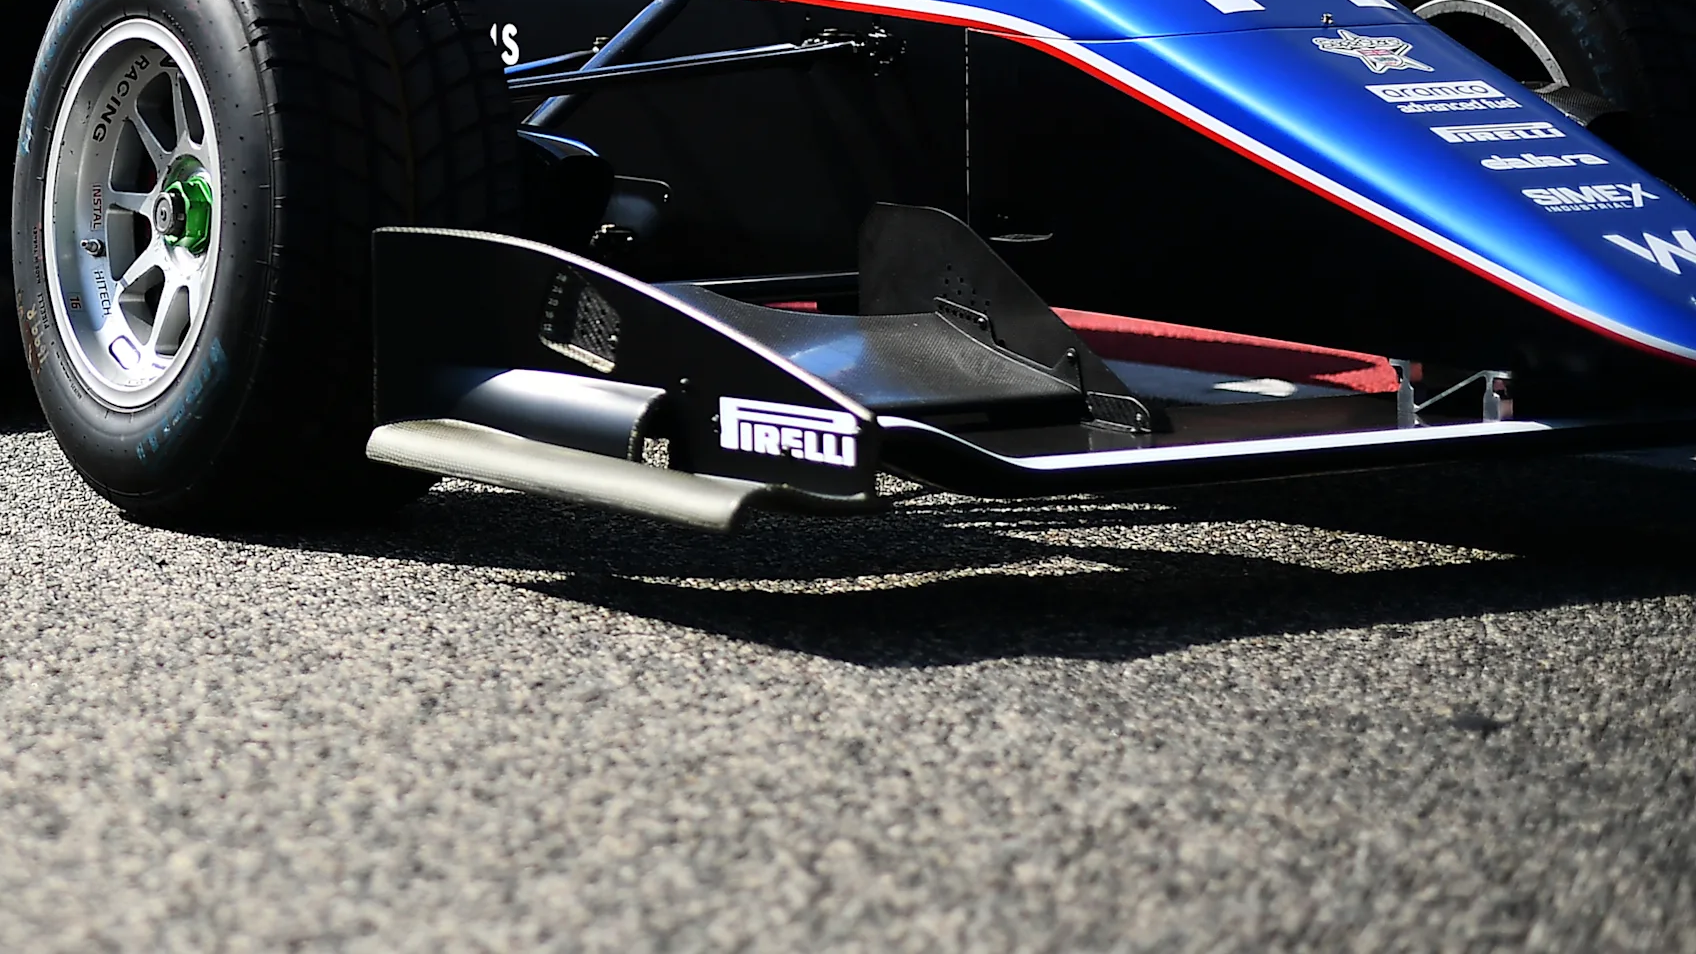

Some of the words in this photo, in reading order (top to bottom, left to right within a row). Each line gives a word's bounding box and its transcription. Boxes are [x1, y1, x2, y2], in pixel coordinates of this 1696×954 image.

[92, 54, 151, 143] RACING
[1379, 81, 1491, 100] aramco
[1396, 98, 1484, 114] advanced
[1481, 97, 1523, 110] fuel
[1429, 121, 1567, 144] PIRELLI
[1480, 153, 1610, 171] dallara
[1521, 182, 1660, 208] SIMEX
[1544, 201, 1634, 213] INDUSTRIAL
[93, 269, 113, 316] HITECH
[719, 396, 860, 467] PIRELLI
